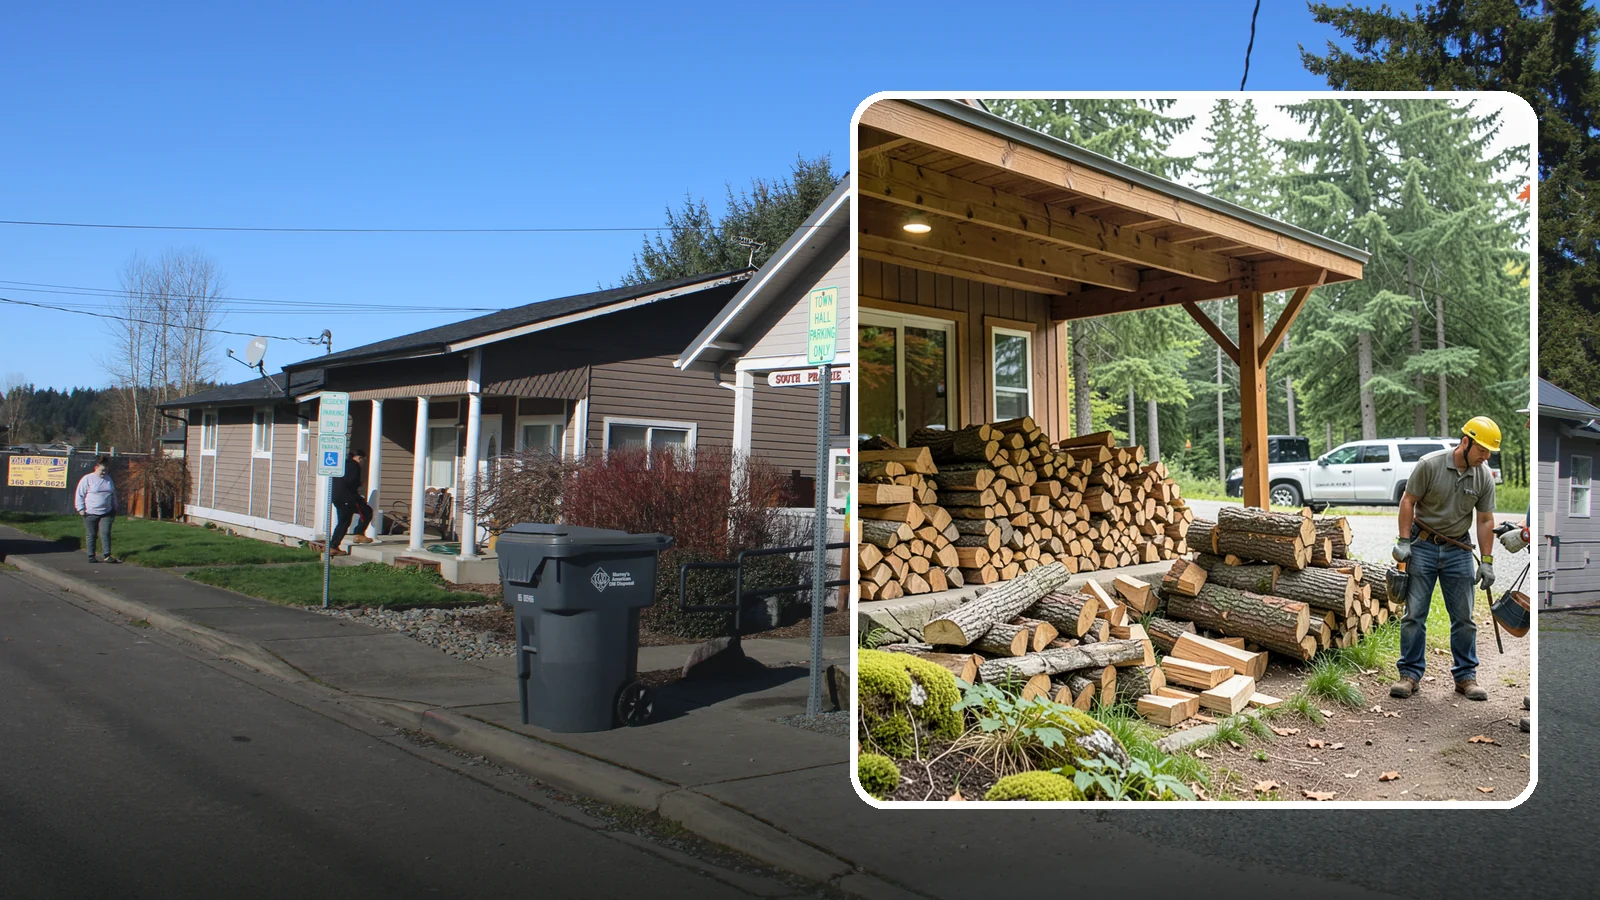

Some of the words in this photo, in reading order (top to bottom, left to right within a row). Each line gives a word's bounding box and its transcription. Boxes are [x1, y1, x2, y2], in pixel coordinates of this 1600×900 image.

[815, 295, 833, 308] TOWN
[814, 311, 831, 324] HALL
[809, 326, 836, 341] PARKING
[813, 344, 831, 357] ONLY
[775, 373, 801, 384] SOUTH
[807, 371, 842, 383] PRIE
[322, 409, 345, 417] PARKING
[325, 420, 340, 428] ONLY
[10, 480, 66, 488] 360-897-8625
